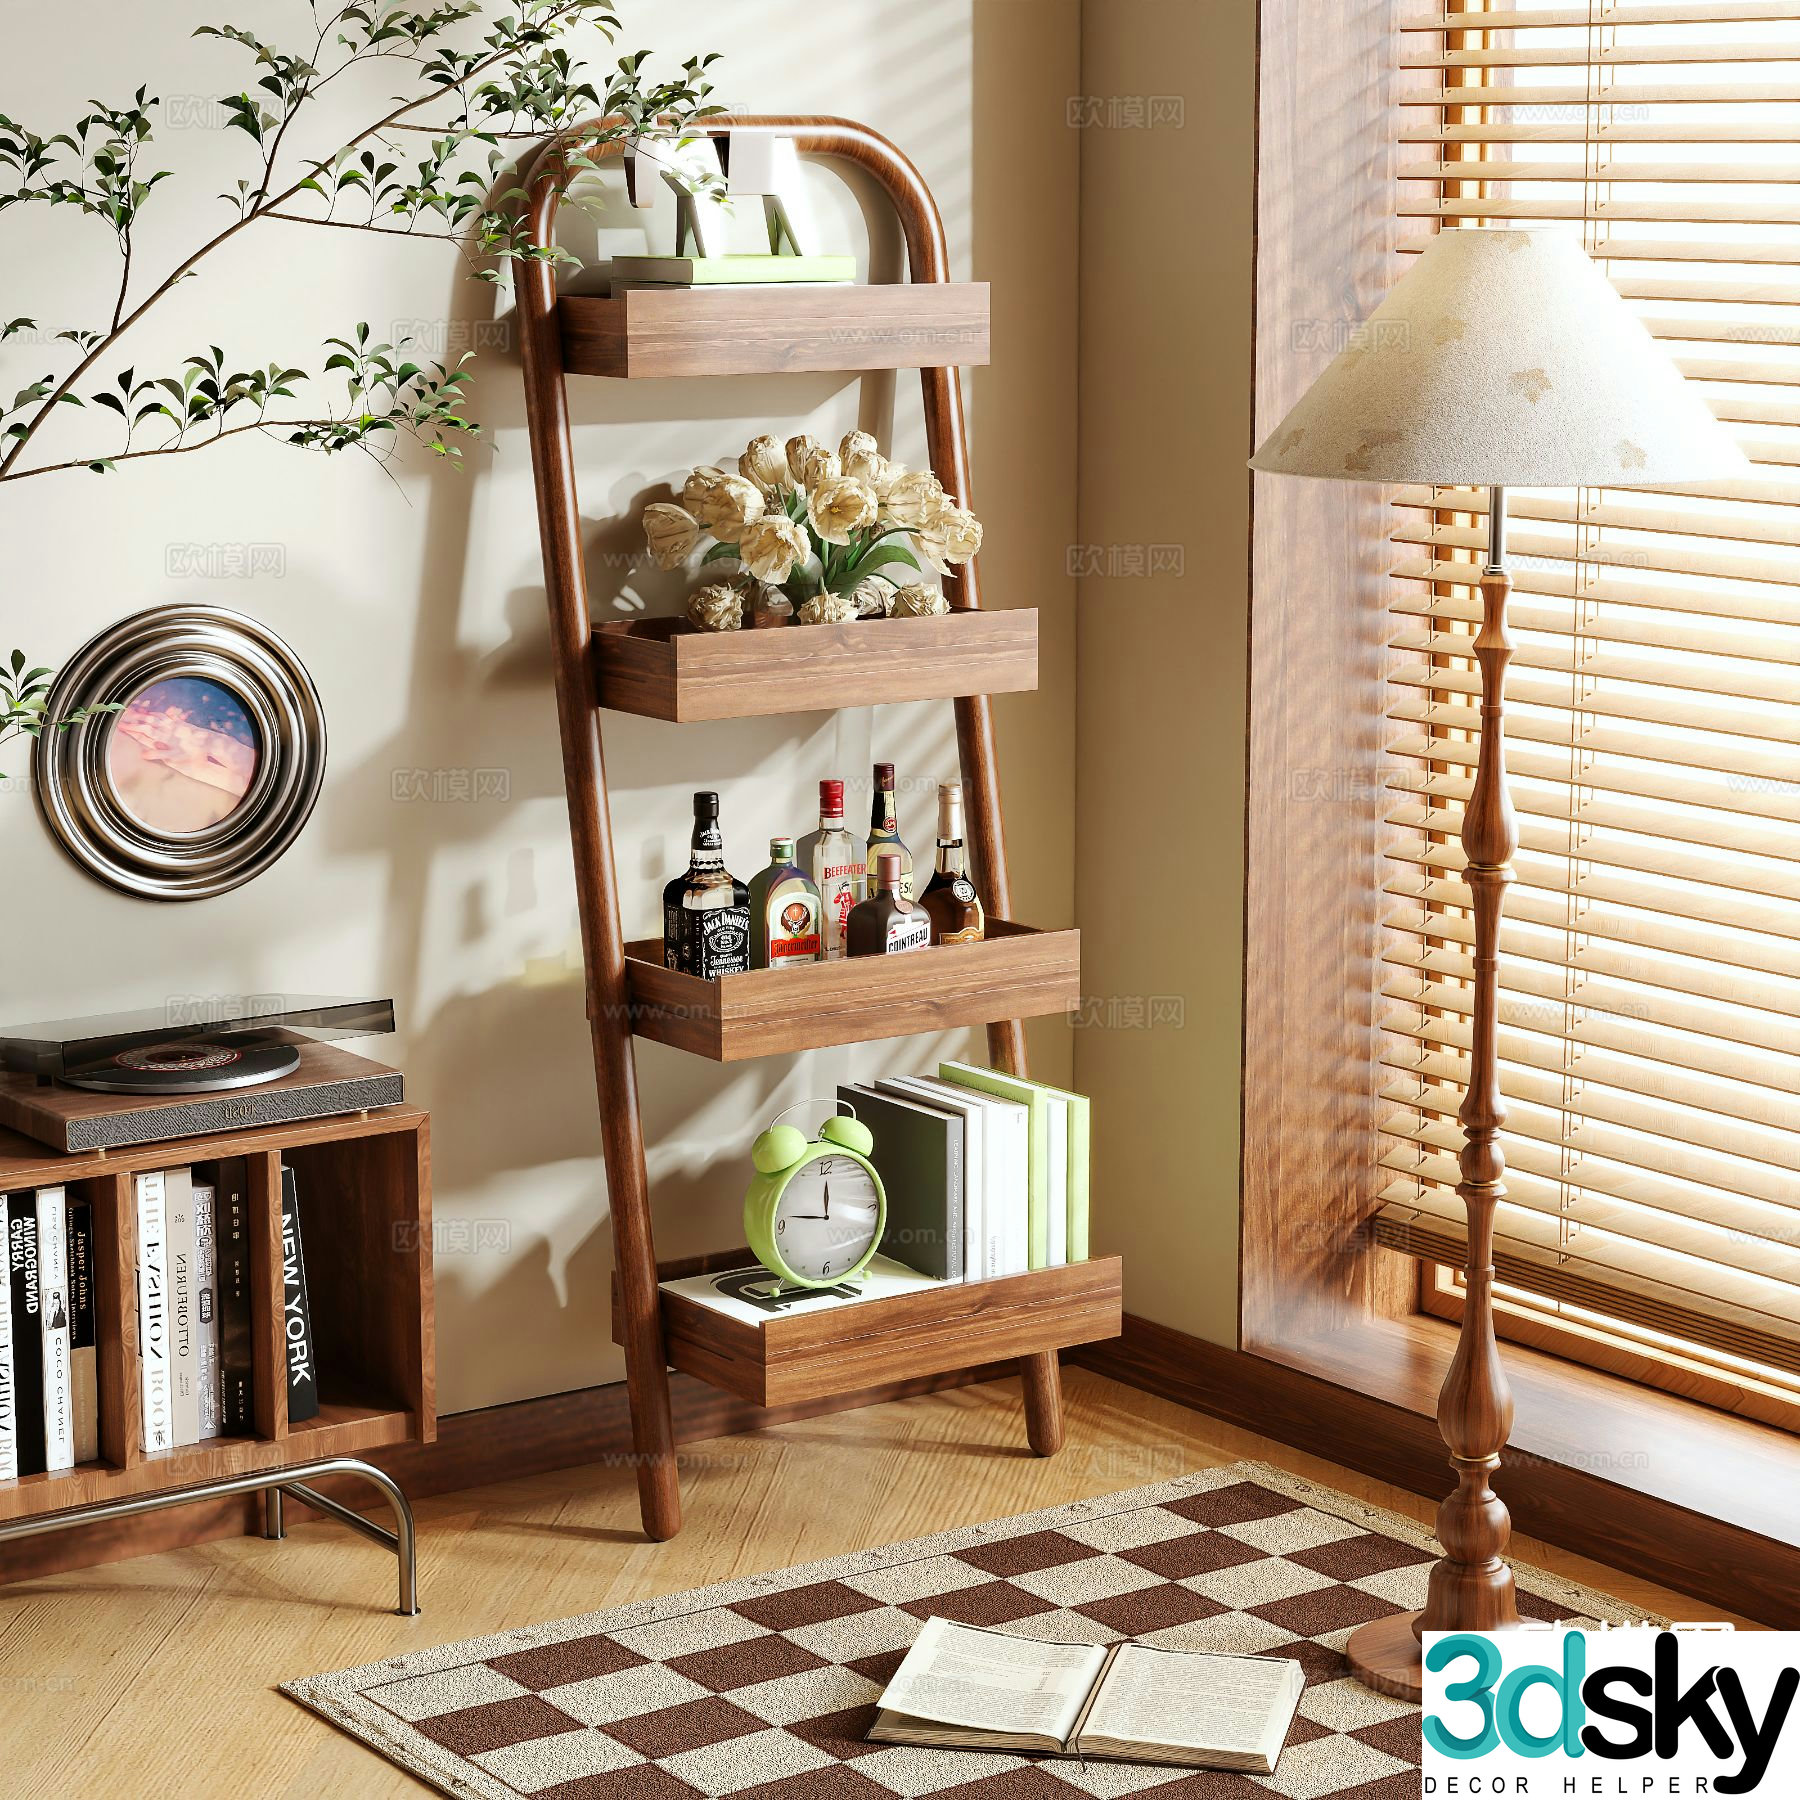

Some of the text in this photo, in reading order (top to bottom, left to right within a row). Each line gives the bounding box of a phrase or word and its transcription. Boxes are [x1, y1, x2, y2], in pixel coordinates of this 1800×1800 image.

[823, 863, 867, 879] BEEFEATER
[703, 911, 749, 935] JACK DANIEL'S
[888, 927, 928, 952] COINTREAU
[709, 955, 744, 967] Tennessee
[708, 965, 745, 978] WHISKEY
[819, 1160, 833, 1176] 12
[777, 1219, 786, 1235] 9
[77, 1231, 87, 1310] Jasper Johns
[822, 1261, 830, 1276] 6
[282, 1213, 311, 1387] NEW YORK
